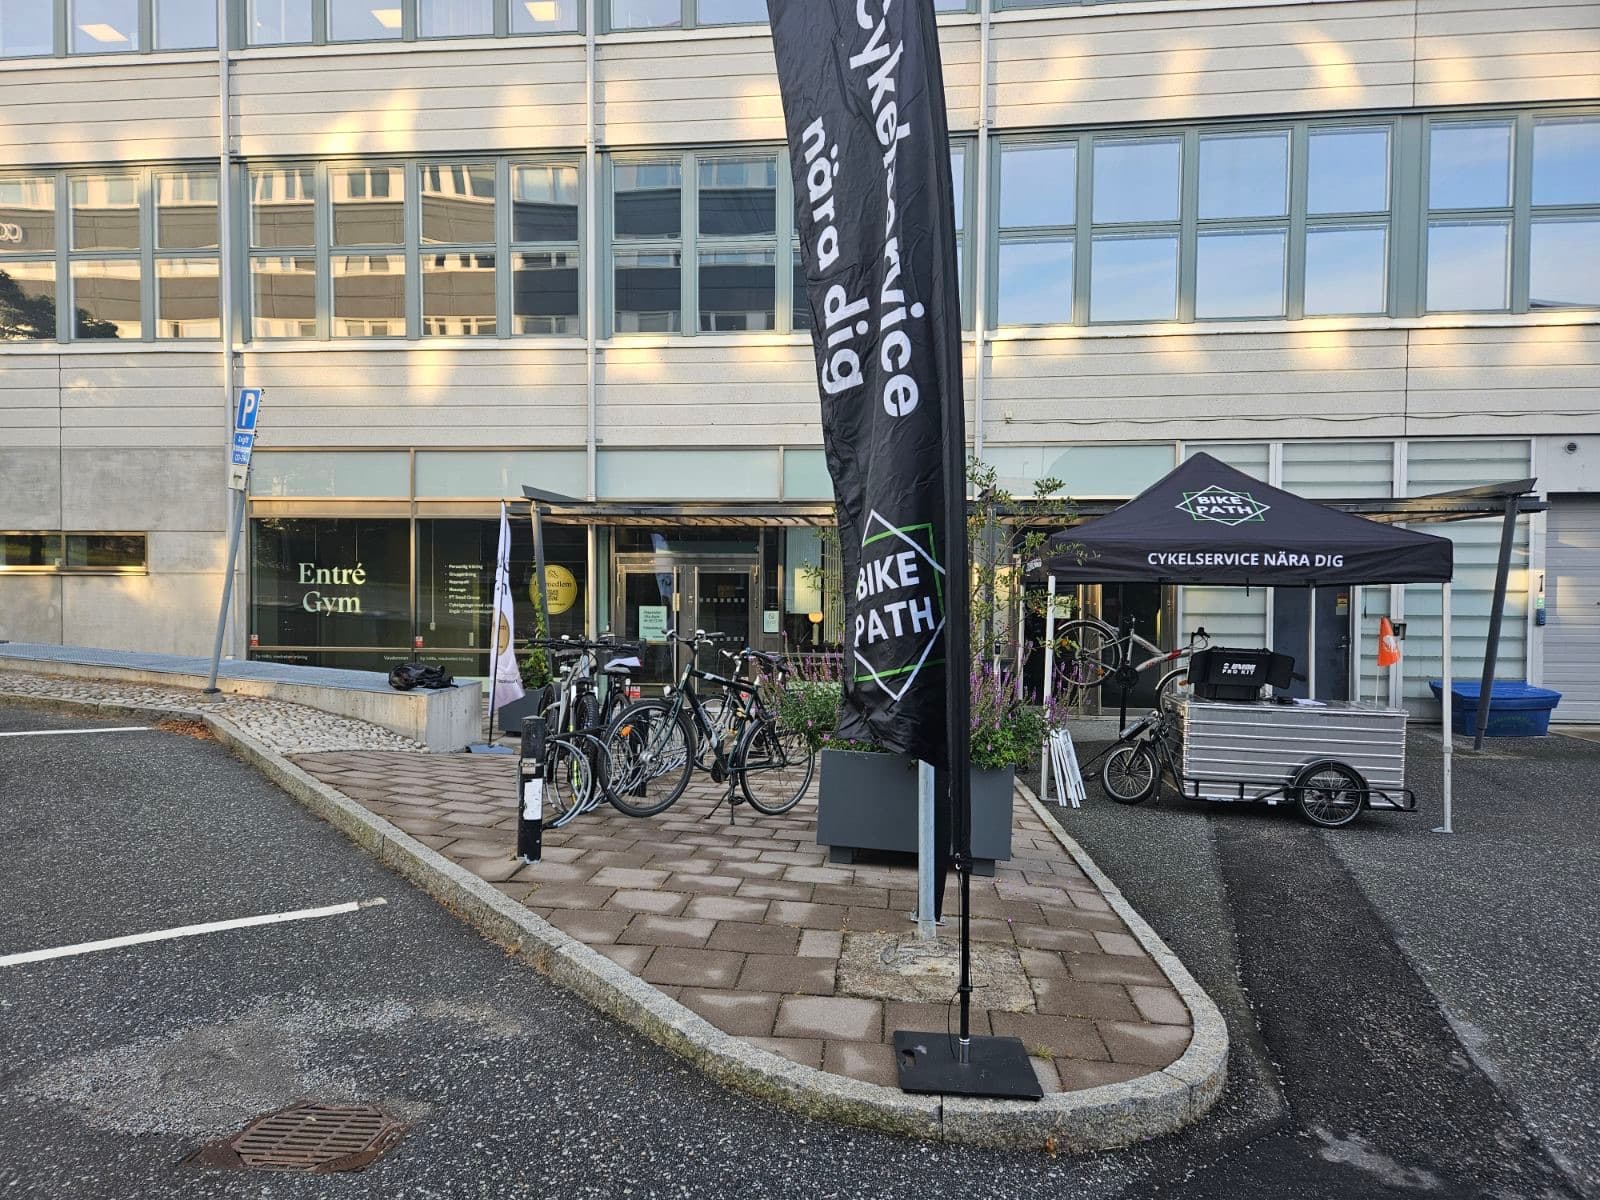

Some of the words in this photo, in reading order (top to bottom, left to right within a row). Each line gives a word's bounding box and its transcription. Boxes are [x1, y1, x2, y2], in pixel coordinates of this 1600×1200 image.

[801, 115, 840, 272] nära
[822, 284, 870, 395] dig
[241, 392, 256, 427] P
[1195, 505, 1254, 515] PATH
[1196, 495, 1244, 505] BIKE
[1147, 552, 1260, 566] CYKELSERVICE
[1263, 551, 1311, 567] NÄRA
[1314, 554, 1344, 568] DIG
[298, 562, 367, 585] Entré
[855, 550, 920, 602] BIKE
[302, 590, 362, 617] Gym
[853, 596, 936, 648] PATH
